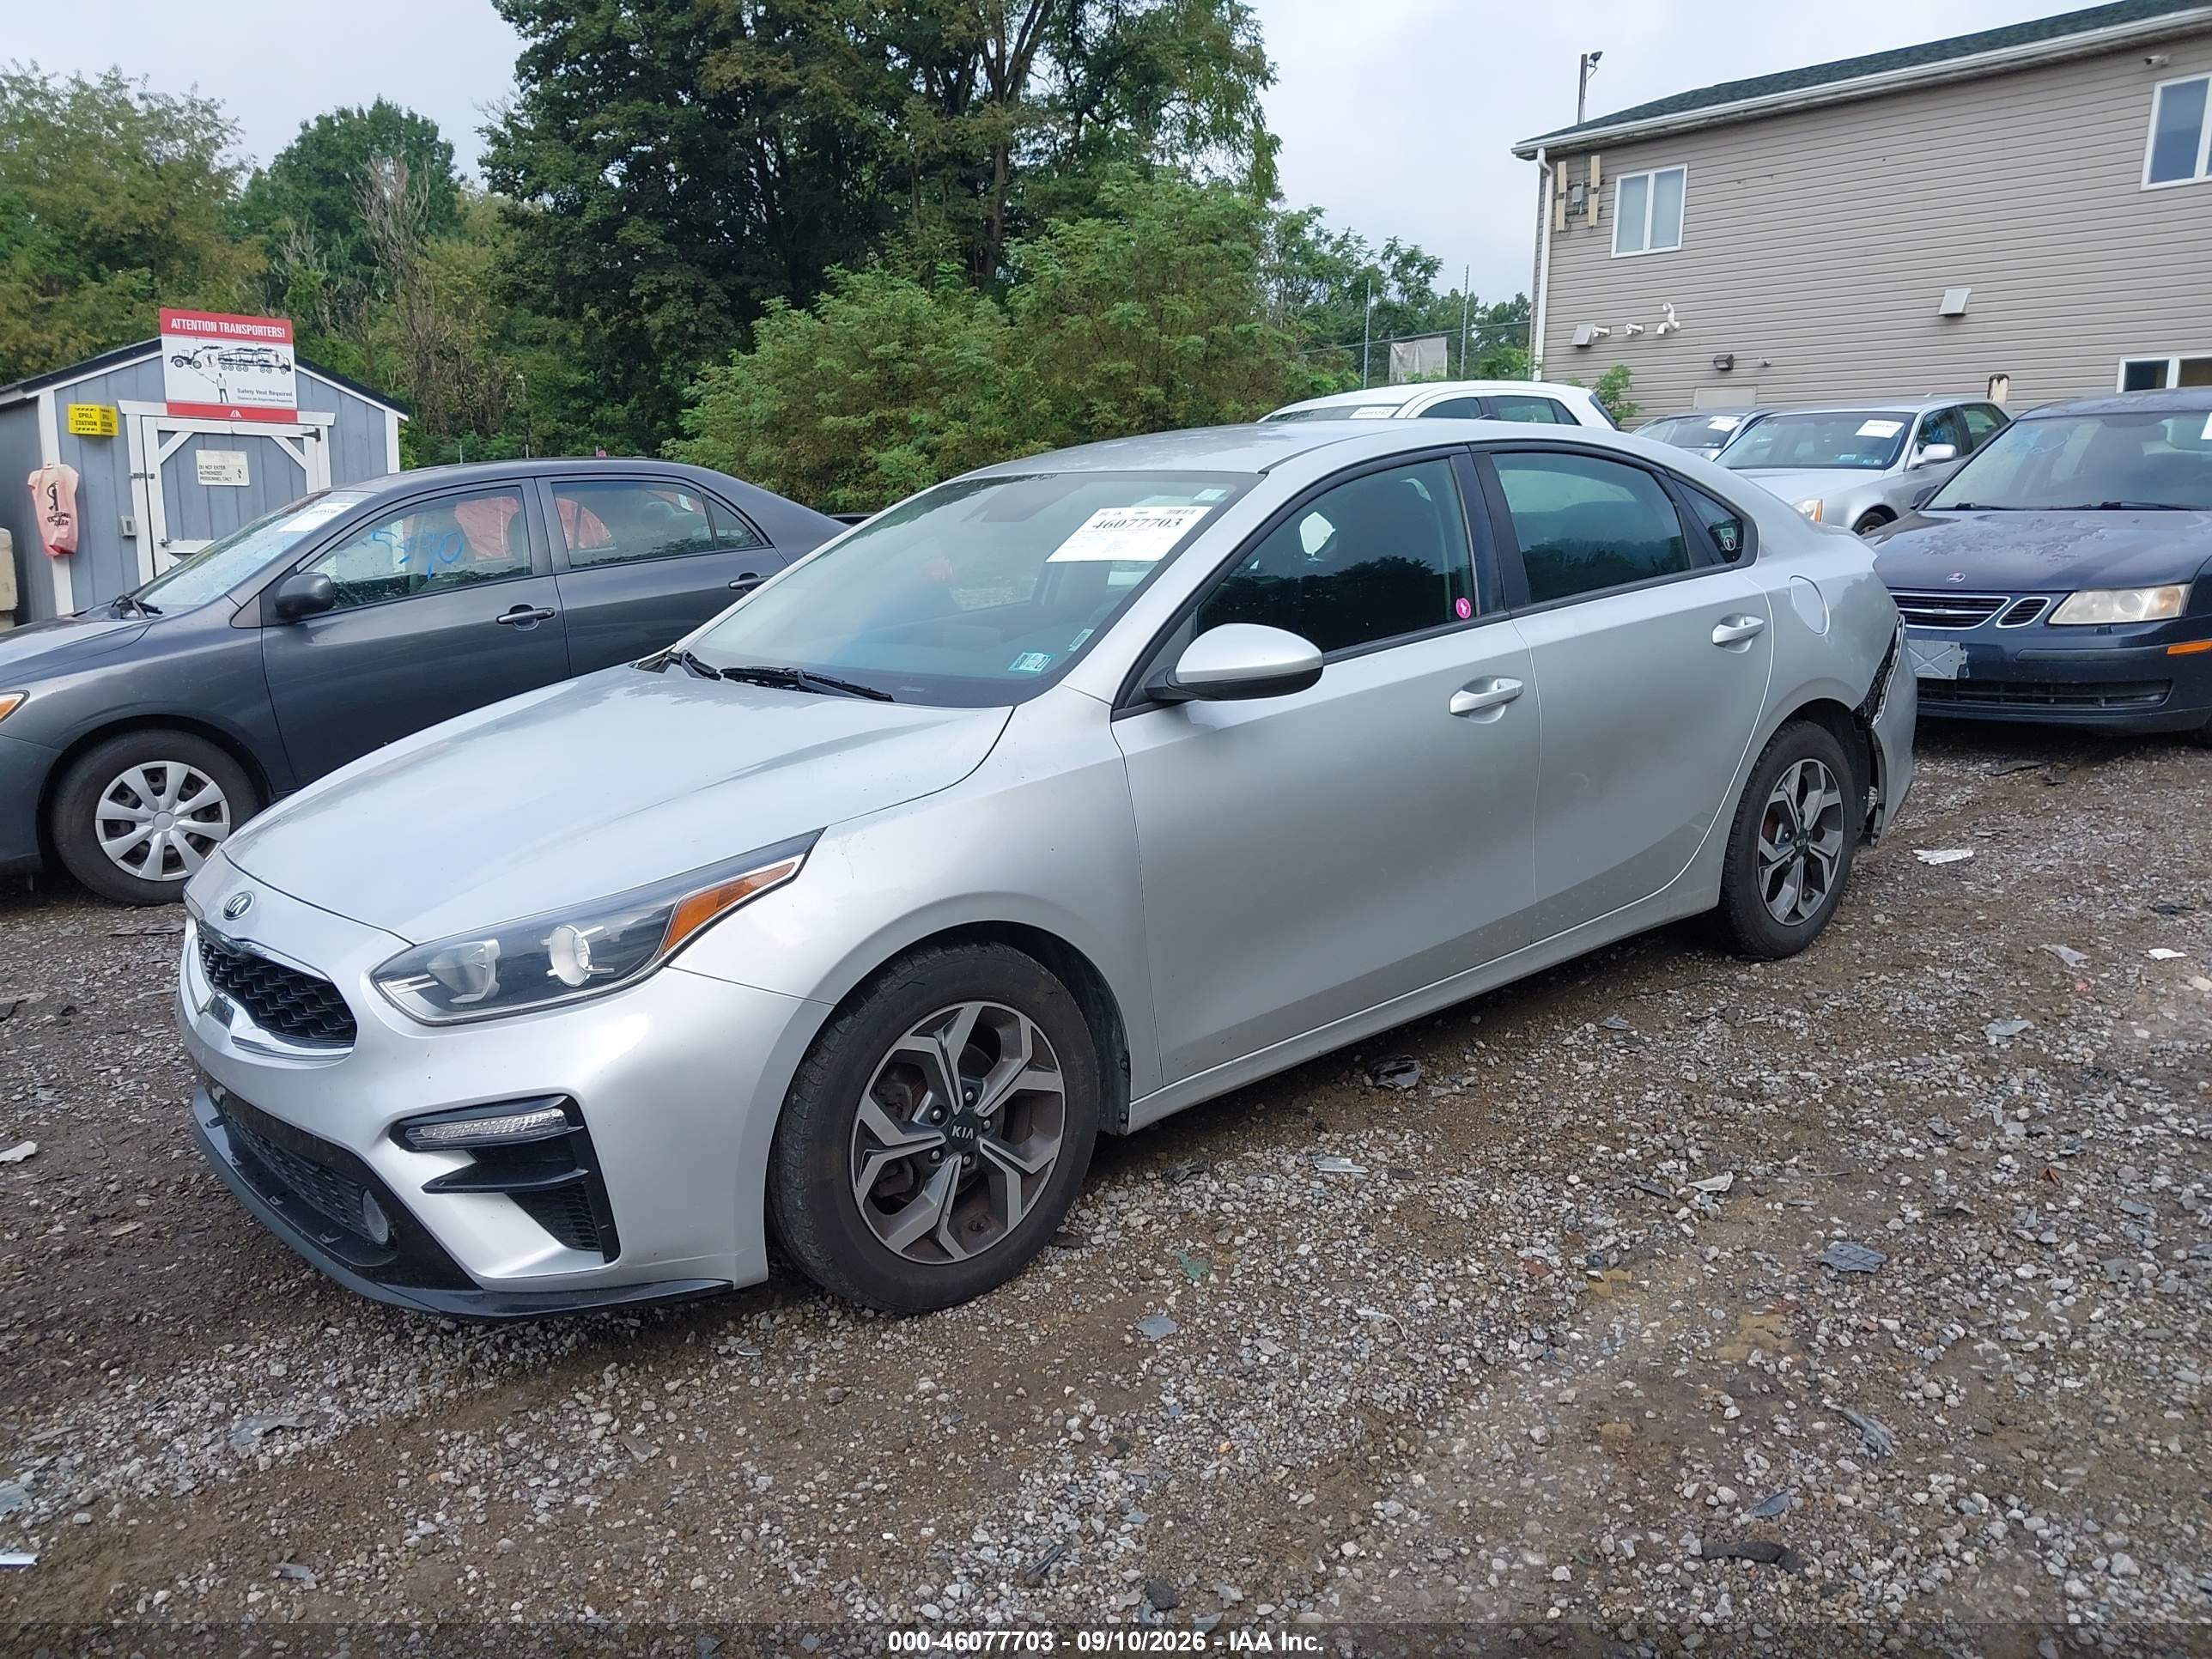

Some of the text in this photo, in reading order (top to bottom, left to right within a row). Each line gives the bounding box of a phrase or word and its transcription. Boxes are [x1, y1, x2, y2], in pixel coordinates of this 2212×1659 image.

[172, 318, 286, 338] ATTENTION TRANSPORTERS!
[1092, 518, 1183, 529] 46077703
[951, 1125, 974, 1139] KIA
